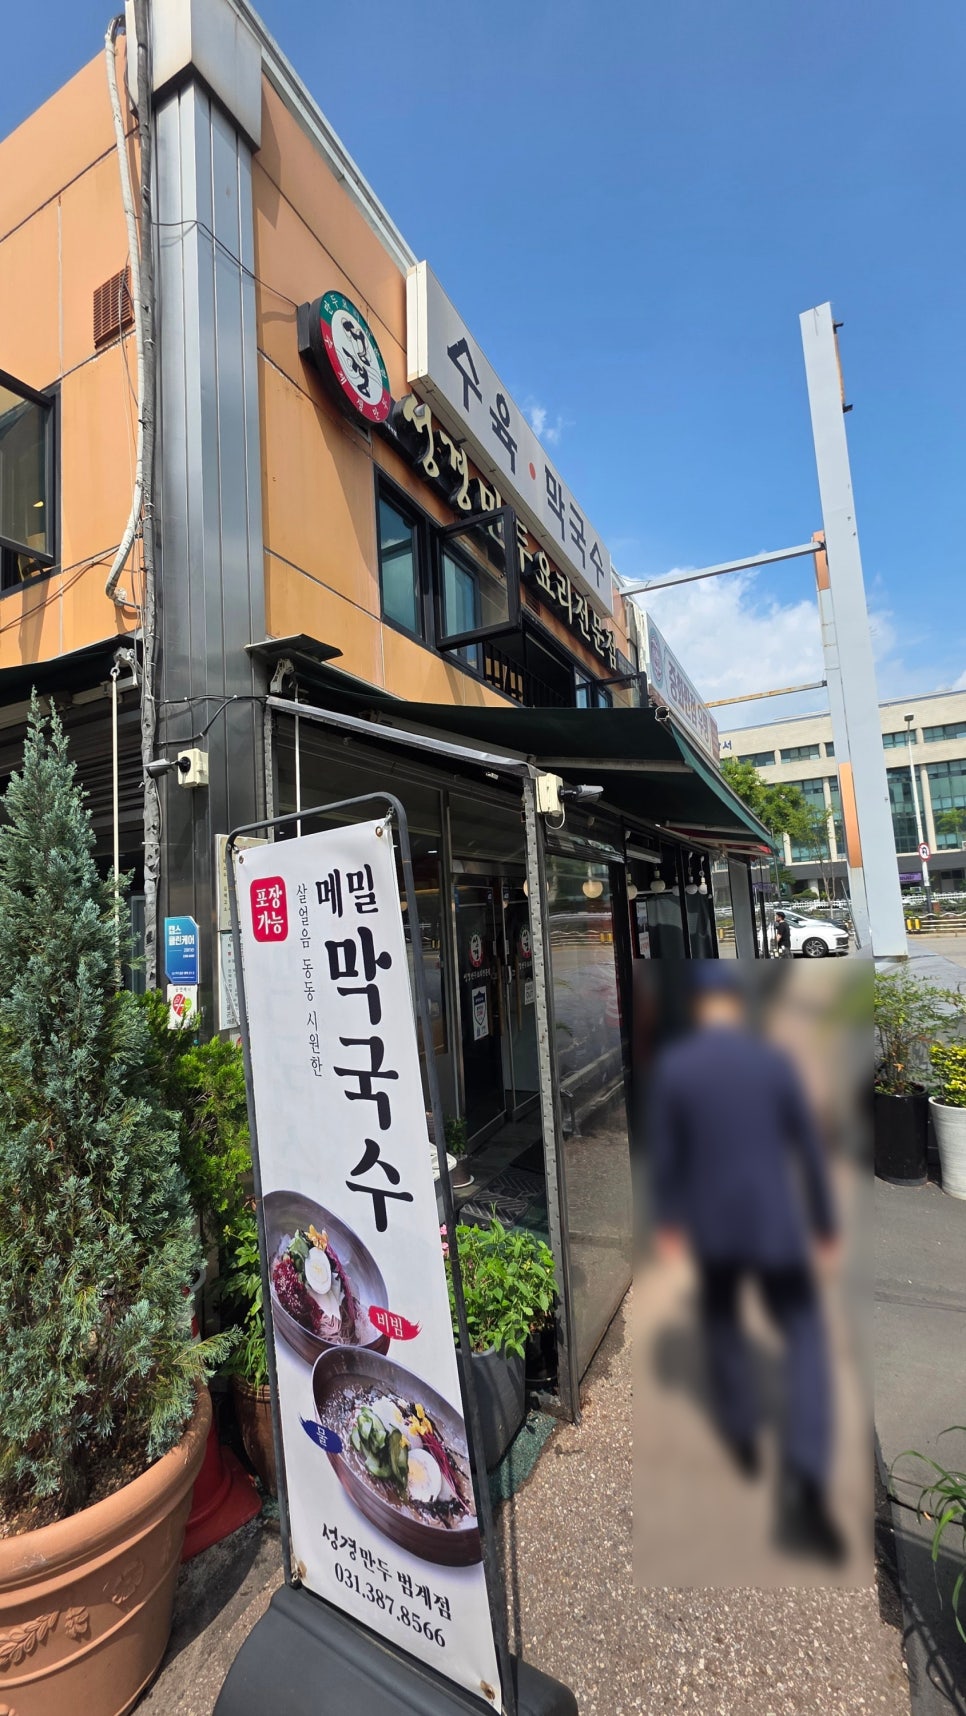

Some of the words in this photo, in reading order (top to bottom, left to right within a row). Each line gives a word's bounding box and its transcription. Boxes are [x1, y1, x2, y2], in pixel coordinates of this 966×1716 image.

[446, 337, 518, 476] 수육
[544, 464, 605, 588] 막국수
[256, 884, 283, 909] 포장
[296, 883, 312, 949] 살얼음
[315, 863, 379, 918] 메밀
[257, 911, 284, 935] 가능
[302, 958, 316, 1002] 동동
[306, 1011, 324, 1078] 시원한
[325, 926, 414, 1232] 막국수
[376, 1312, 404, 1338] 비빔
[316, 1427, 328, 1448] 물
[334, 1562, 446, 1648] 031.387.8566
[396, 1570, 452, 1622] 범계점
